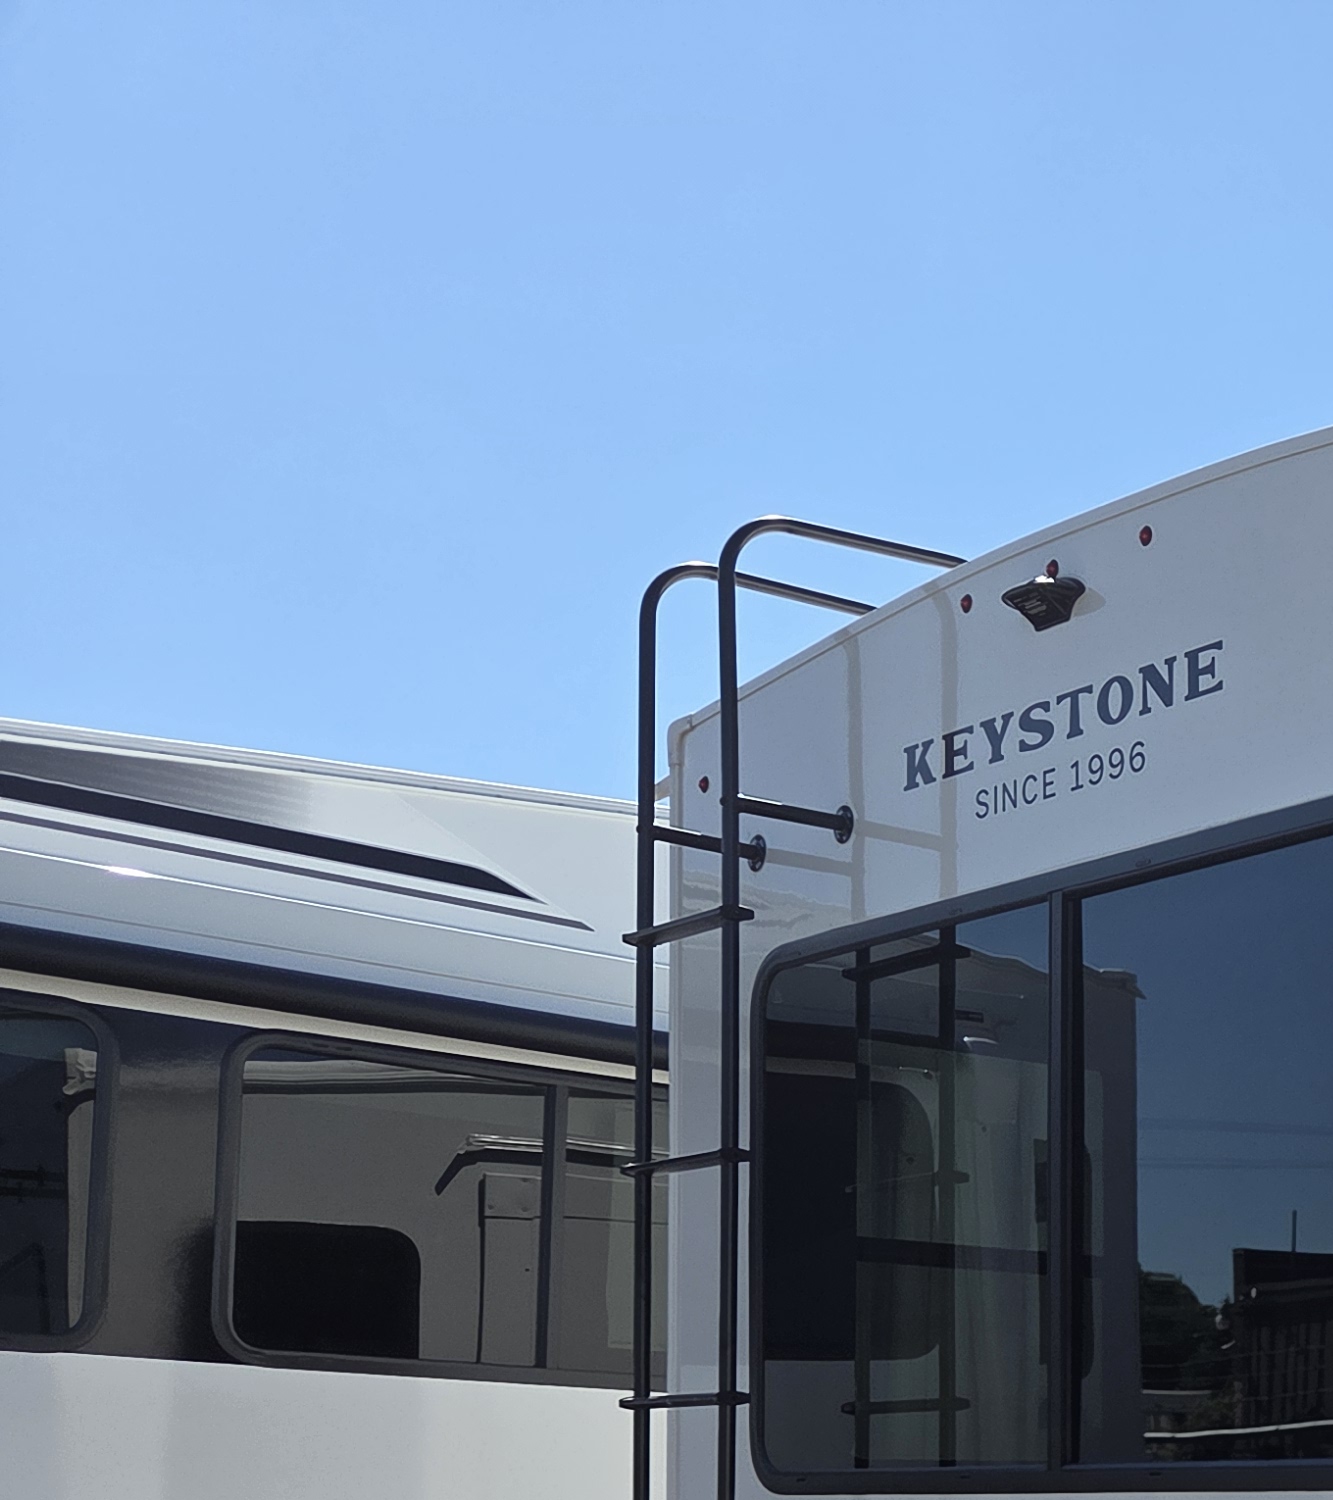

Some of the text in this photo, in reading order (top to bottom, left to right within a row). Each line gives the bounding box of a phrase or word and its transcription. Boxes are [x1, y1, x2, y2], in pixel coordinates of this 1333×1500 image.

[902, 639, 1225, 793] KEYSTONE
[975, 740, 1146, 820] SINCE 1996
